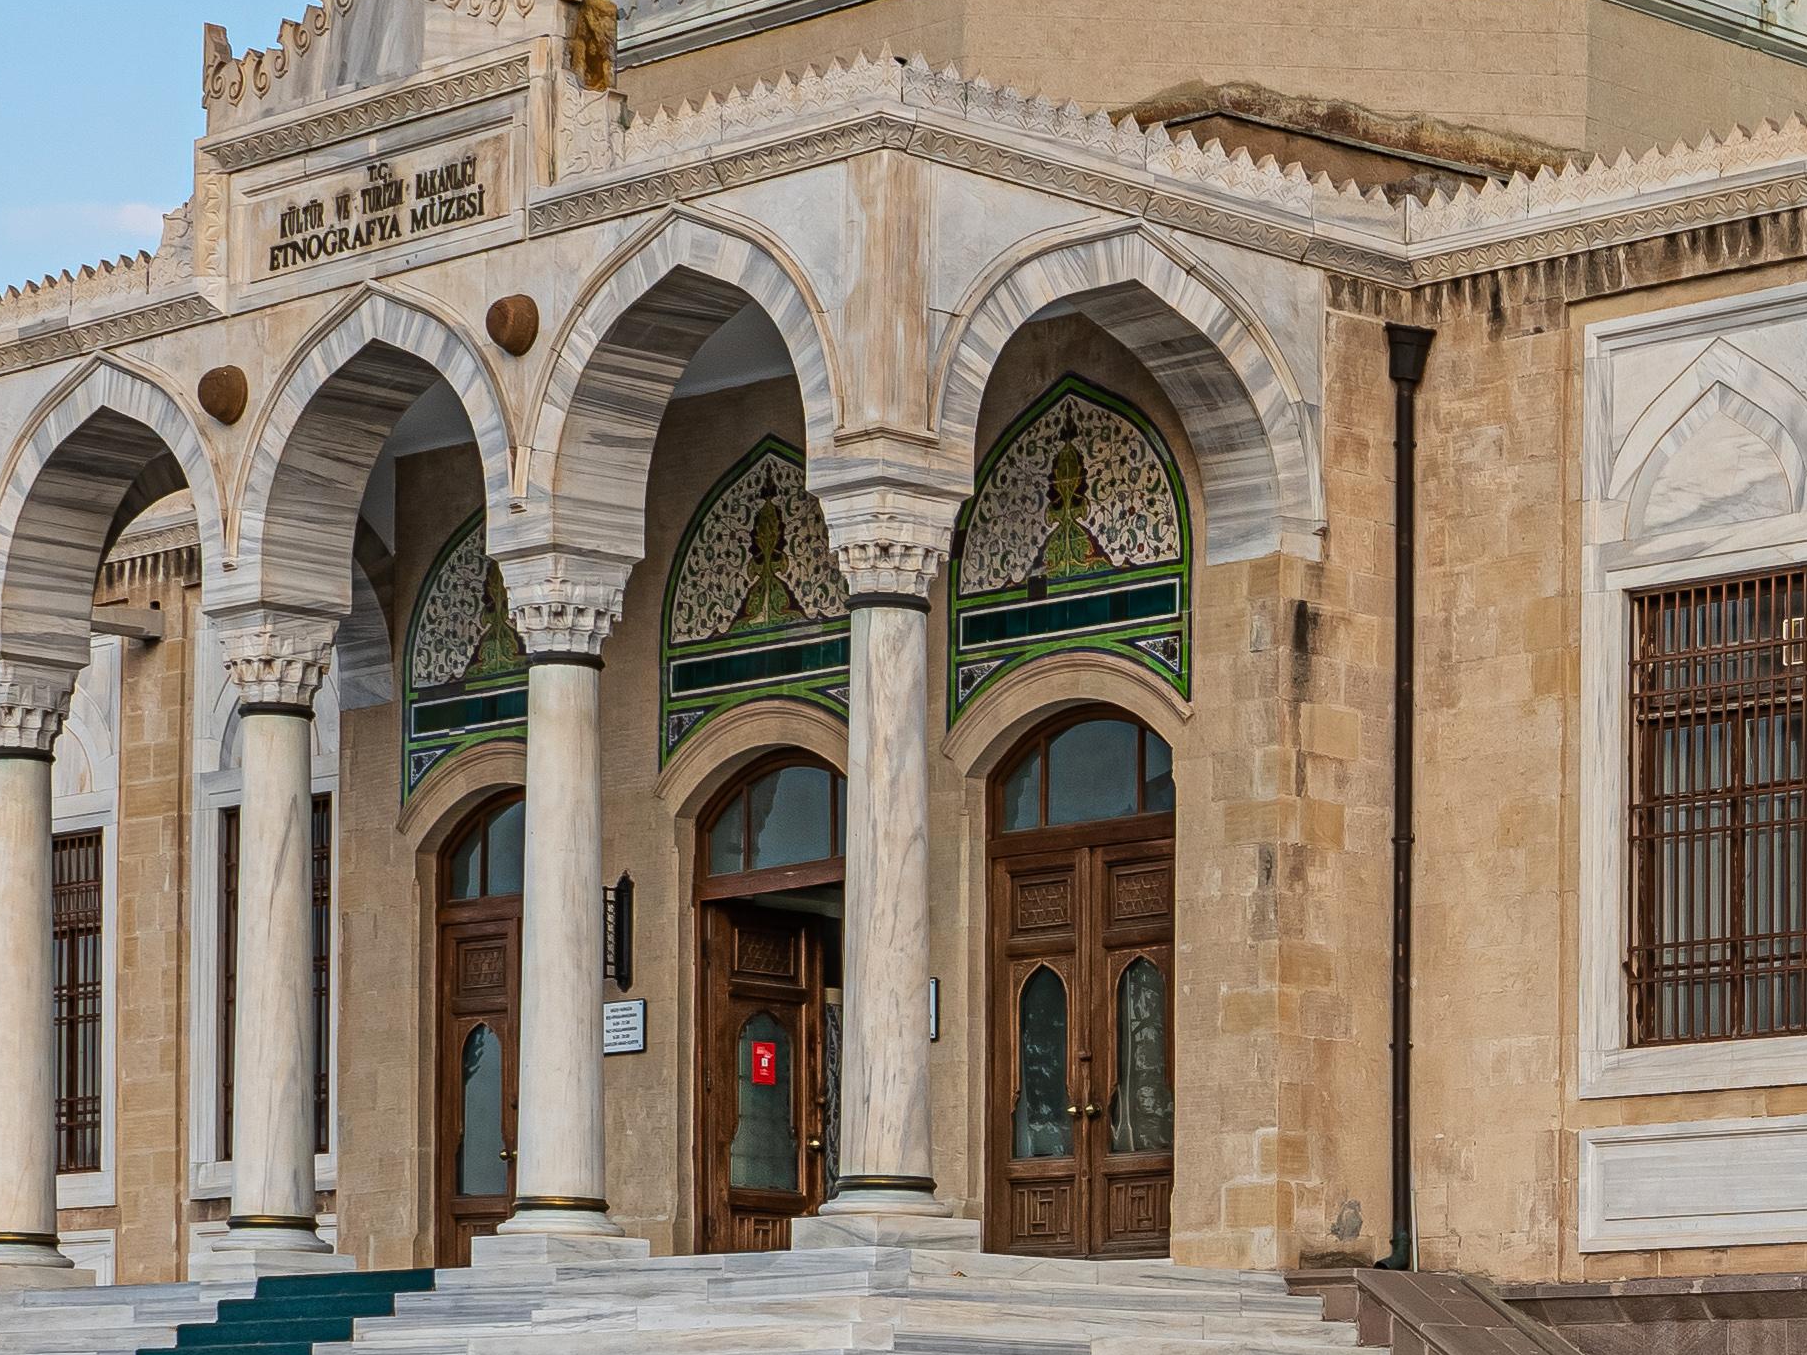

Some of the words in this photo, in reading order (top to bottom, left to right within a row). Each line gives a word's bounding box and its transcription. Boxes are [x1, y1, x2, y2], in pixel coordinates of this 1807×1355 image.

[280, 199, 324, 239] KÜLTÜR
[335, 194, 351, 223] VE
[360, 179, 405, 215] TURİZM
[415, 156, 478, 200] BAKANLIĞI
[410, 184, 486, 234] MÜZESİ
